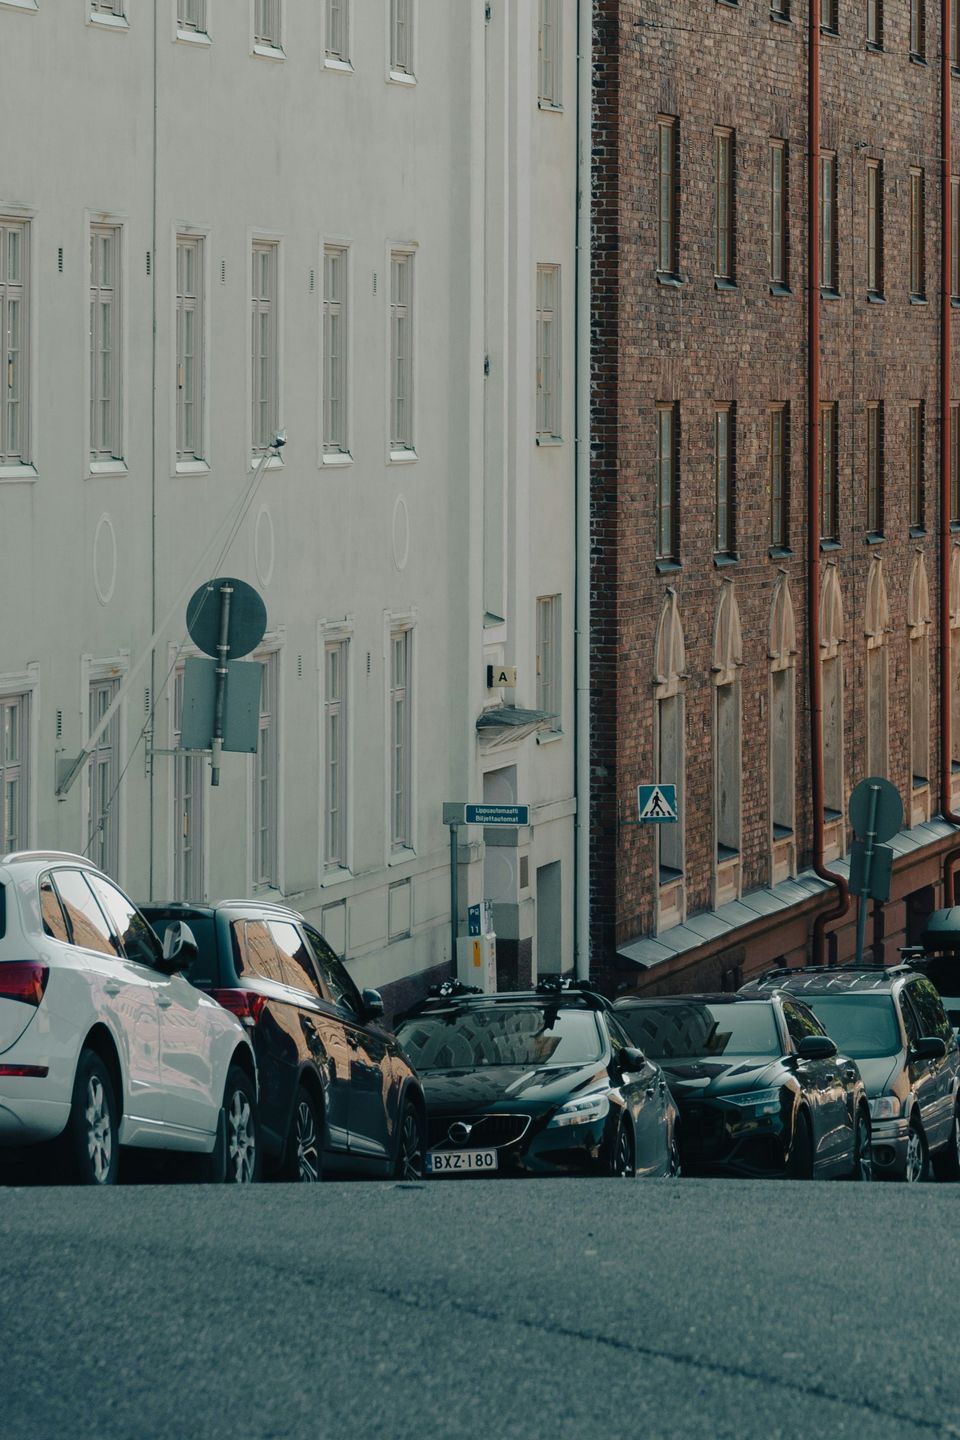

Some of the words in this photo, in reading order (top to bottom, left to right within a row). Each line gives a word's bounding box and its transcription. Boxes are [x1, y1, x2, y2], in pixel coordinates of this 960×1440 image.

[498, 671, 508, 682] A
[475, 807, 519, 815] Lippuautomaatti
[475, 815, 519, 823] Biljettautomat
[470, 926, 479, 934] 11
[433, 1153, 493, 1169] BXZ-180
